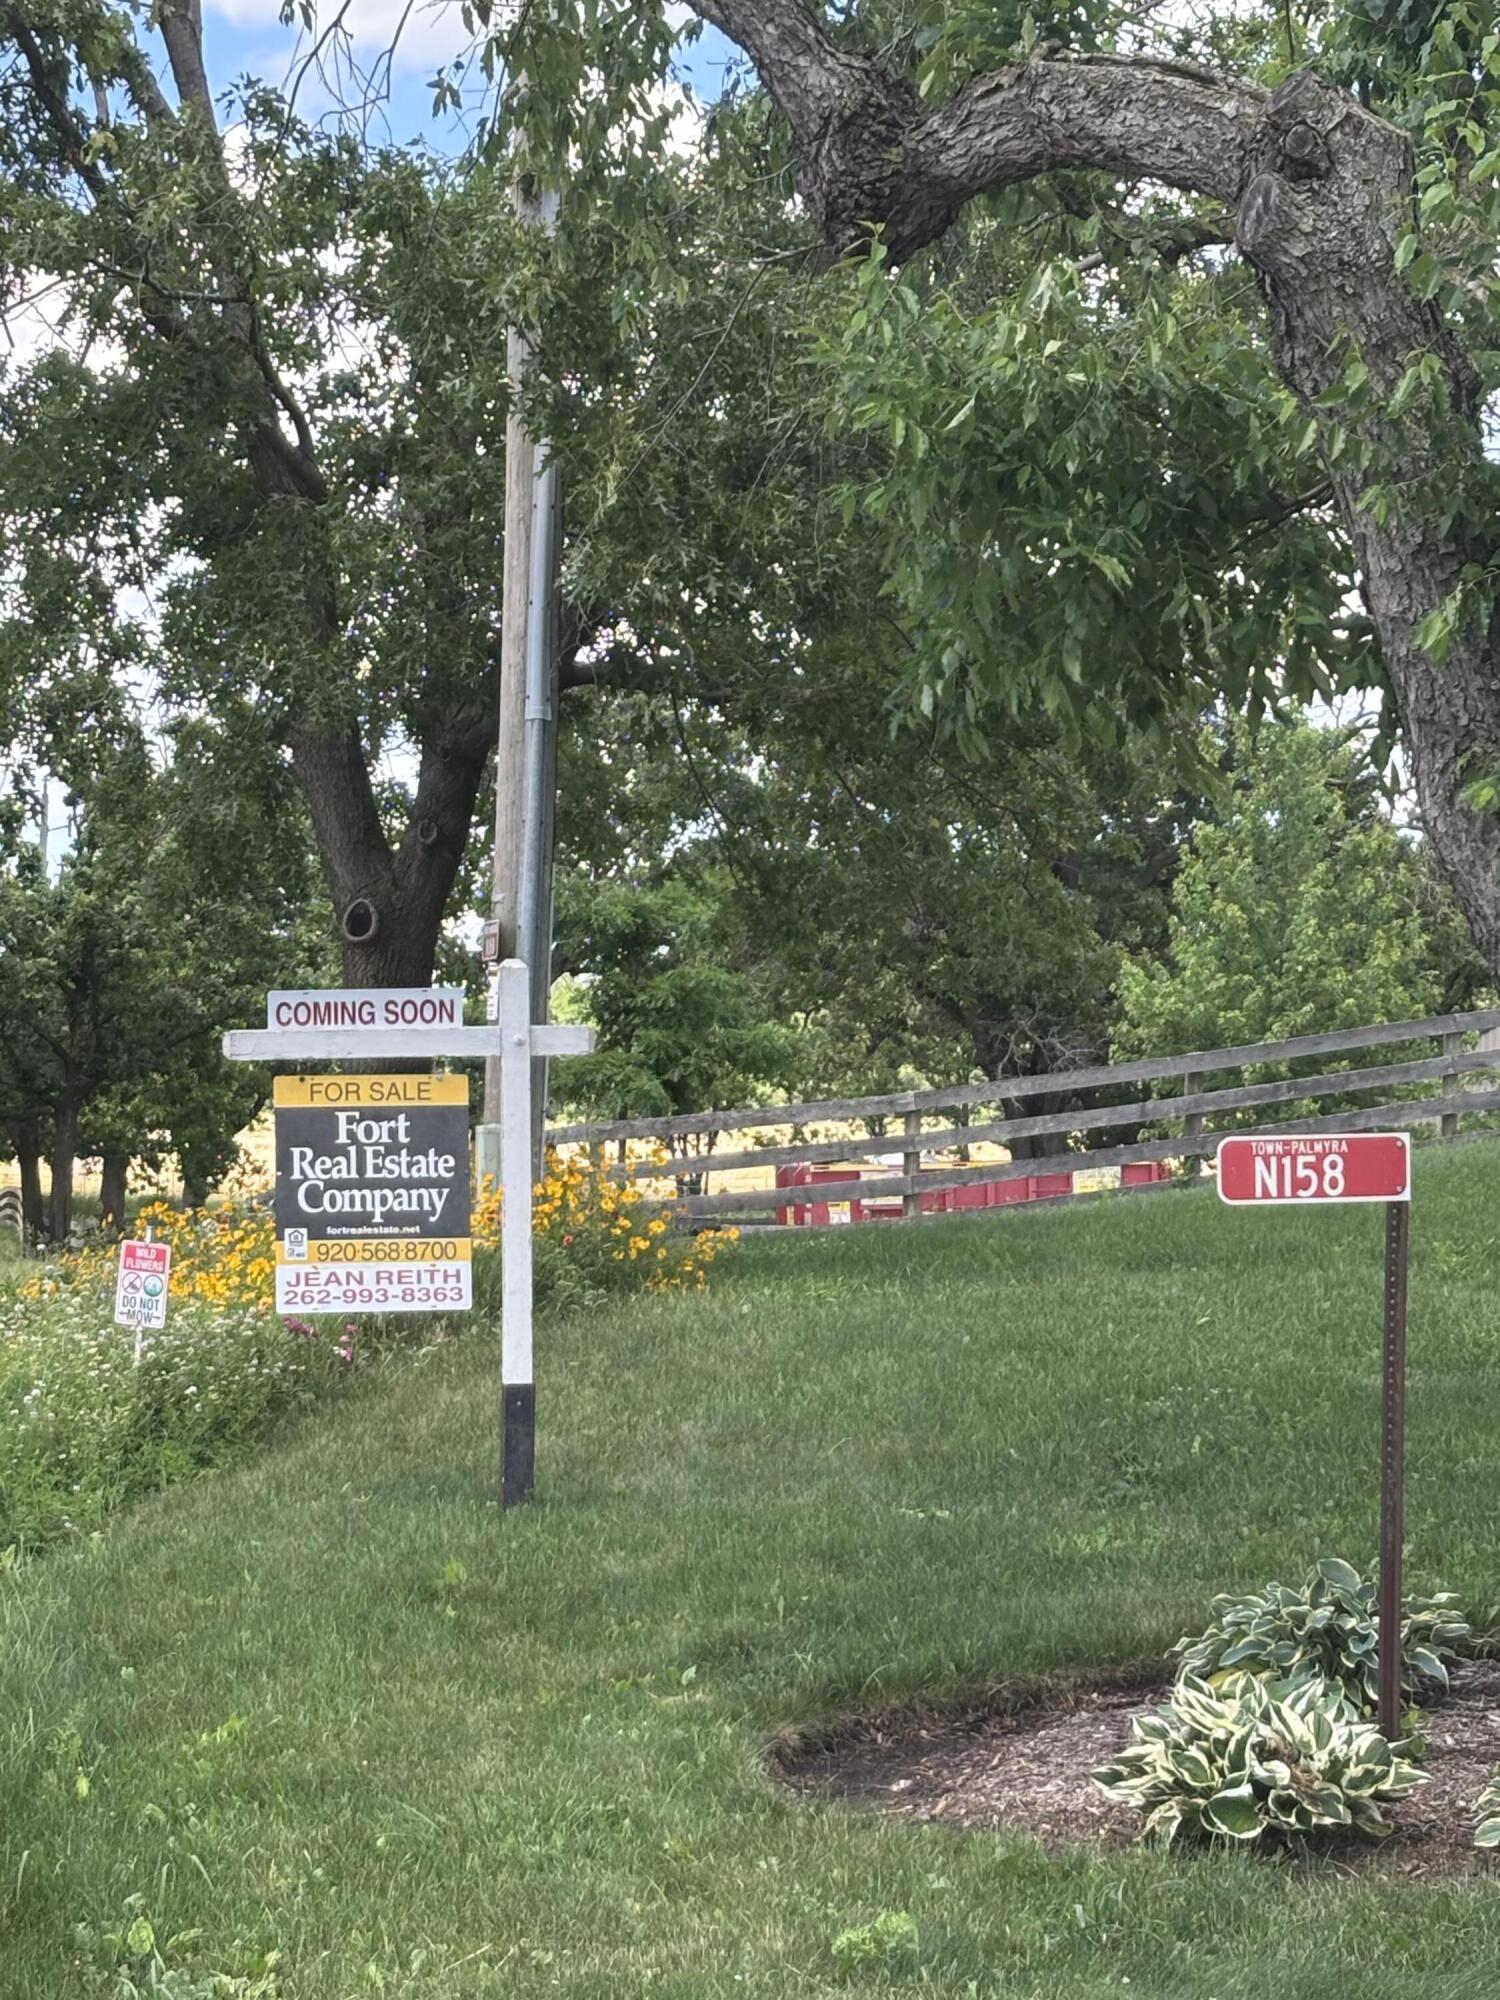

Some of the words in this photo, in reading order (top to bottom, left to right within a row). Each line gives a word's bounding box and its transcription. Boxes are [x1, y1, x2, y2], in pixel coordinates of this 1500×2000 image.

[276, 1001, 375, 1027] COMING
[384, 999, 455, 1025] SOON
[309, 1082, 360, 1102] FOR
[369, 1081, 432, 1101] SALE
[335, 1111, 411, 1144] Fort
[1251, 1140, 1349, 1155] TOWN-PALMYRA
[290, 1147, 359, 1181] Real
[365, 1146, 455, 1179] Estate
[1254, 1153, 1345, 1198] N158
[297, 1180, 450, 1224] Company
[326, 1225, 420, 1235] fortrealestate.net
[135, 1248, 156, 1259] WILD
[126, 1257, 164, 1271] FLOWERS
[286, 1271, 364, 1288] JEAN
[375, 1268, 461, 1285] REITH
[122, 1296, 137, 1309] DO
[139, 1298, 160, 1311] NOT
[284, 1287, 464, 1305] 262-993-8363
